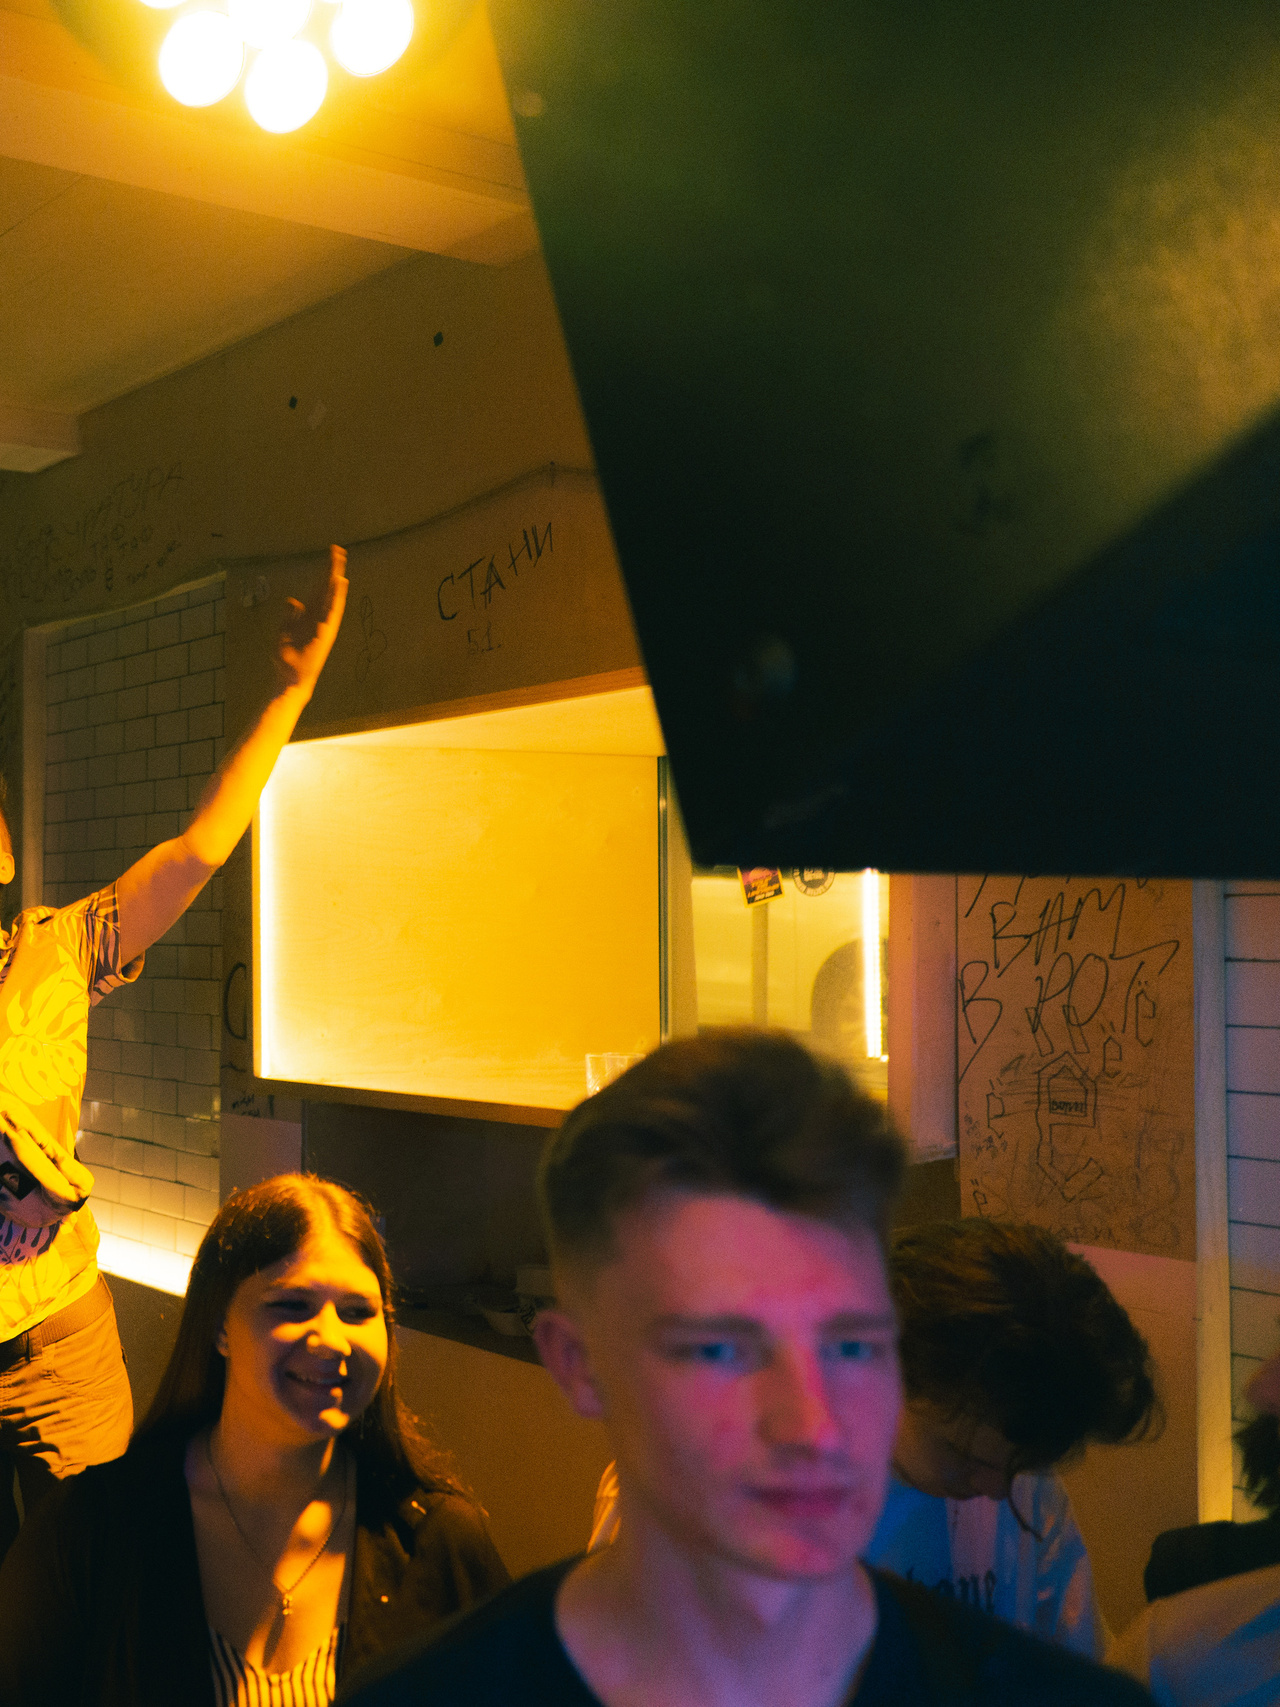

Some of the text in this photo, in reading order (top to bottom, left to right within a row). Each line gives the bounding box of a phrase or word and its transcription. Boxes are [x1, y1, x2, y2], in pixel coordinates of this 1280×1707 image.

[437, 521, 554, 621] СТАНИ
[990, 883, 1126, 978] ВАМ
[958, 961, 1003, 1085] В
